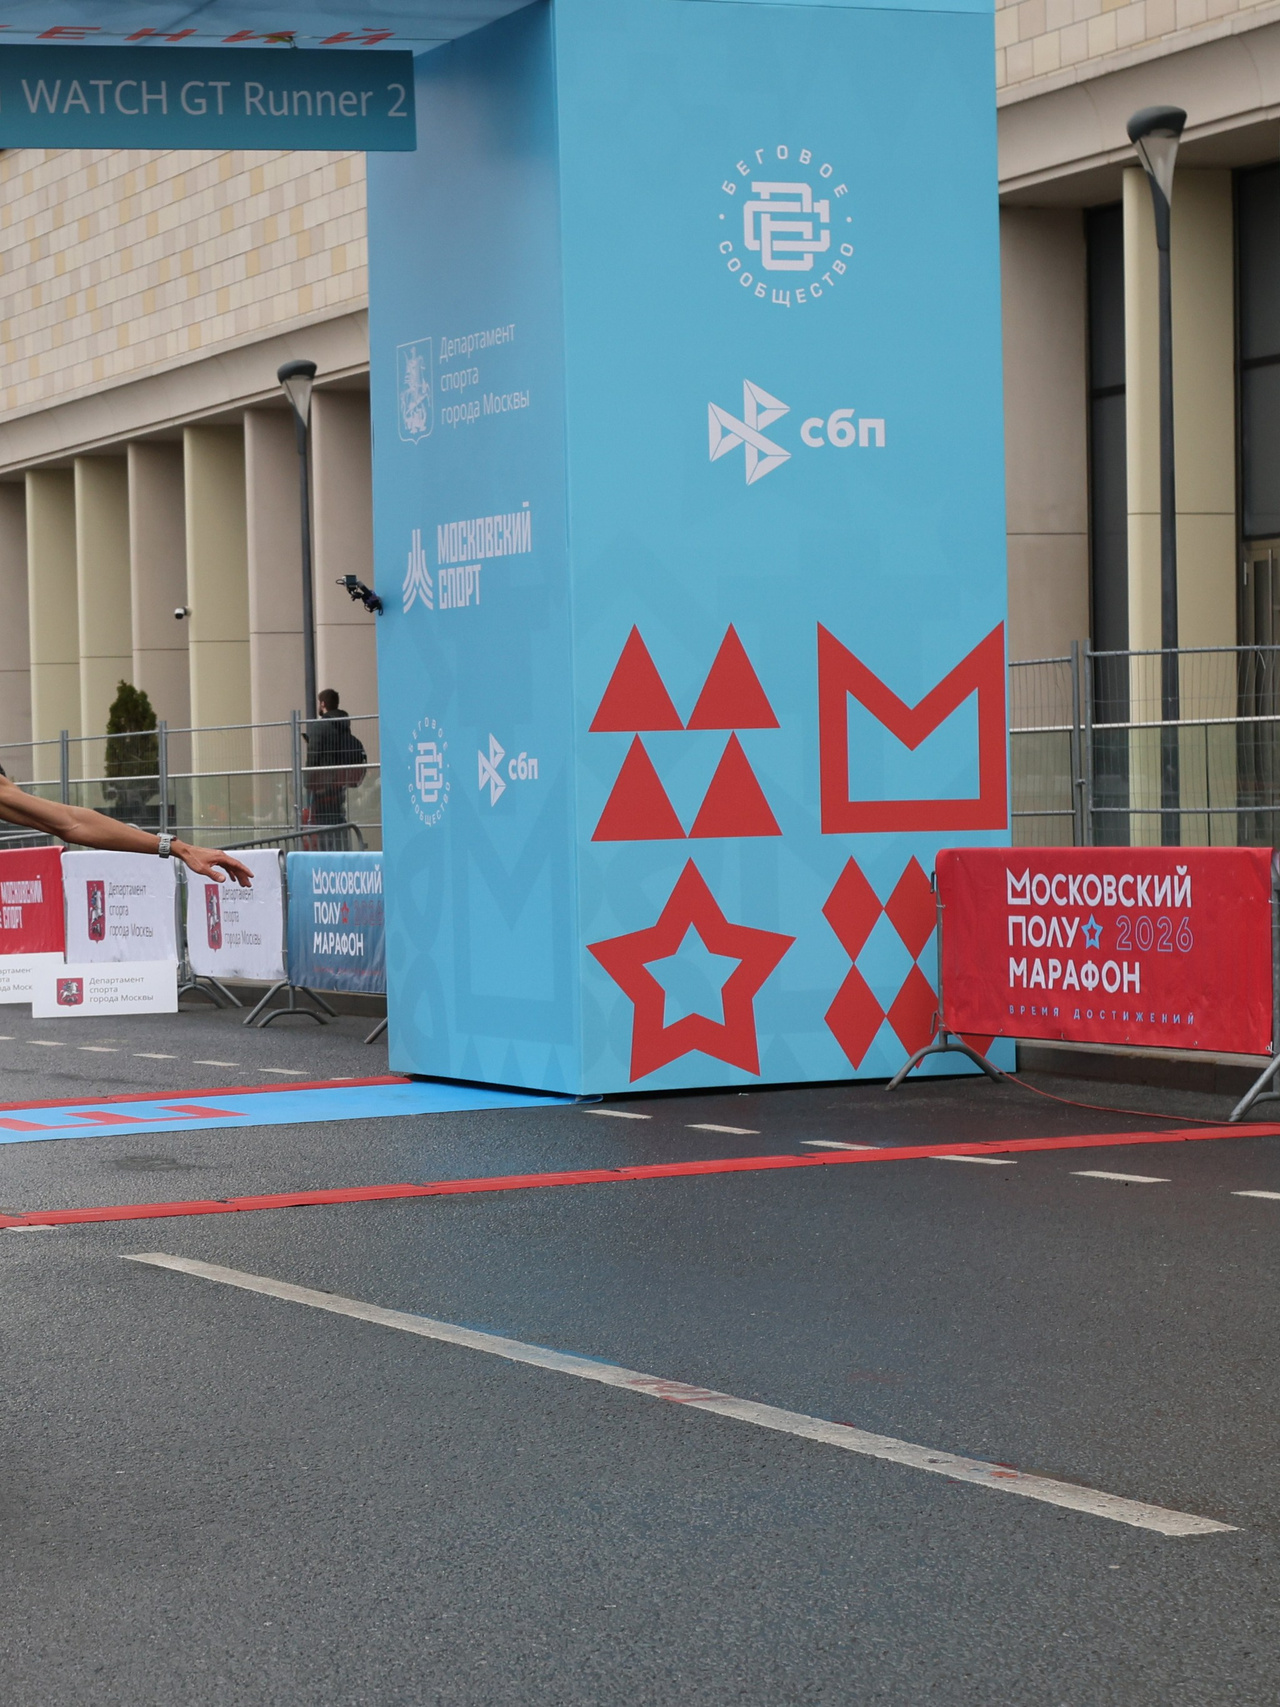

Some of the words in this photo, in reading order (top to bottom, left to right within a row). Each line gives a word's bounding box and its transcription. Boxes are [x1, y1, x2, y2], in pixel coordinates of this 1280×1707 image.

[21, 79, 168, 115] WATCH
[181, 80, 231, 116] GT
[245, 82, 373, 117] Runner
[387, 83, 408, 117] 2
[722, 145, 848, 198] БЕГОВОЕ
[719, 240, 854, 308] СООБЩЕСТВО
[439, 324, 516, 364] Департамент
[440, 367, 479, 394] спорта
[441, 400, 480, 429] города
[483, 390, 530, 416] Москвы
[800, 408, 886, 448] сбп
[437, 501, 532, 565] МОСКОВСКИЙ
[438, 564, 482, 610] СПОРТ
[508, 751, 538, 780] сбп
[0, 874, 44, 905] МОСКОВСКИЙ
[108, 882, 147, 899] Департамент
[312, 864, 382, 894] МОСКОВСКИЙ
[1006, 865, 1192, 908] МОСКОВСКИЙ
[2, 905, 23, 929] СПОРТ
[109, 904, 129, 919] спорта
[314, 902, 341, 924] ПОЛУ
[109, 924, 130, 939] города
[130, 923, 154, 938] Москвы
[241, 931, 262, 946] Москвы
[313, 931, 364, 956] МАРАФОН
[1008, 915, 1080, 948] ПОЛУ
[1116, 915, 1194, 953] 2026
[89, 976, 144, 985] Департамент
[89, 986, 118, 994] спорта
[1009, 957, 1140, 994] МАРАФОН
[89, 995, 119, 1003] города
[1009, 1004, 1059, 1017] ВРЕМЯ
[1073, 1009, 1195, 1025] ДОСТИЖЕНИЙ
